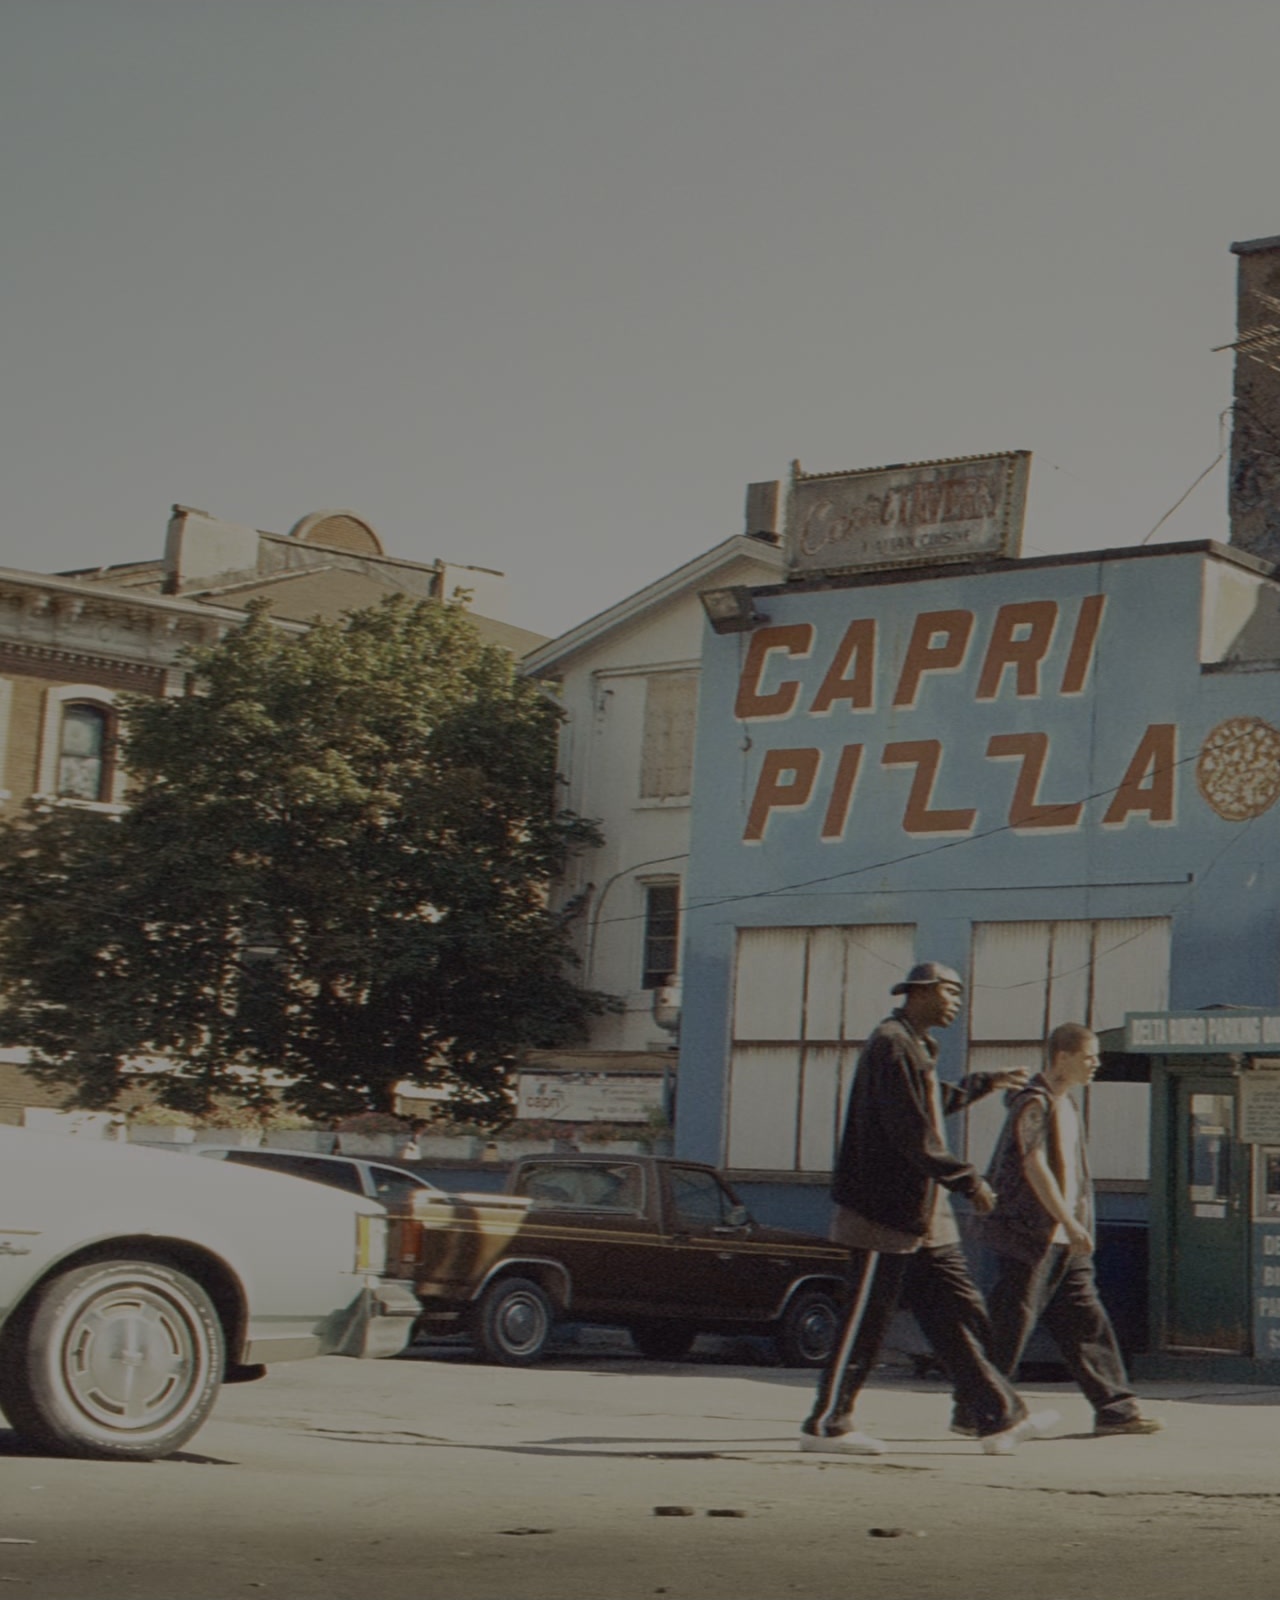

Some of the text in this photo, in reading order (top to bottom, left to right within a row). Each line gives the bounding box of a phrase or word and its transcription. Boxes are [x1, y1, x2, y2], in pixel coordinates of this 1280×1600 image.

[734, 594, 1107, 722] CAPRI
[742, 724, 1179, 845] PIZZA
[1132, 1018, 1167, 1046] DELTA
[1168, 1018, 1206, 1045] BINGO
[1208, 1016, 1261, 1045] PARKING
